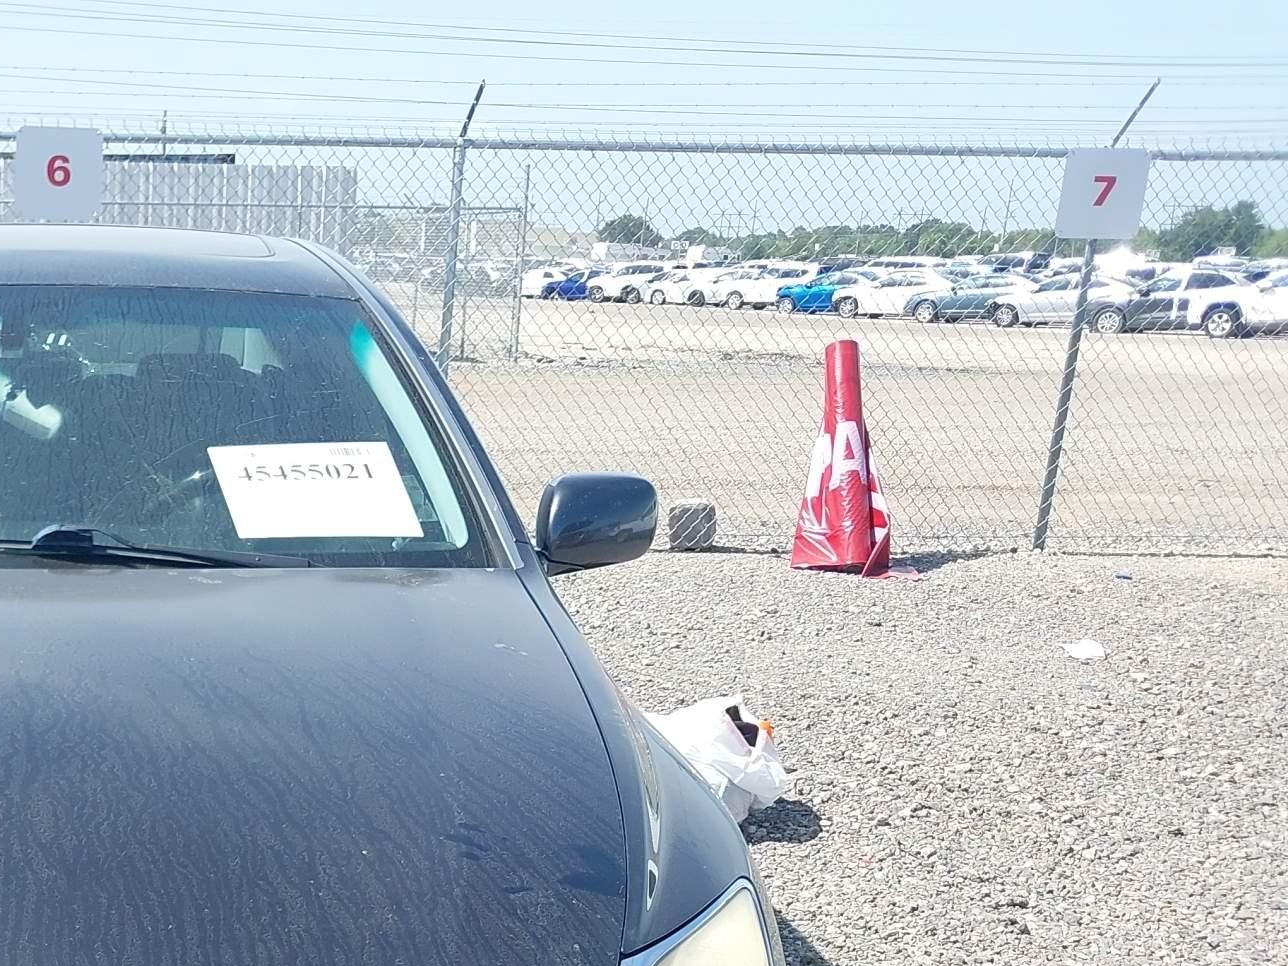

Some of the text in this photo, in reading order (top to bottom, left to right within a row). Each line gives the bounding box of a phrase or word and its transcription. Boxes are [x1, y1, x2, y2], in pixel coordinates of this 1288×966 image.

[46, 154, 71, 187] 6
[1092, 175, 1118, 207] 7
[237, 463, 374, 482] 45455021
